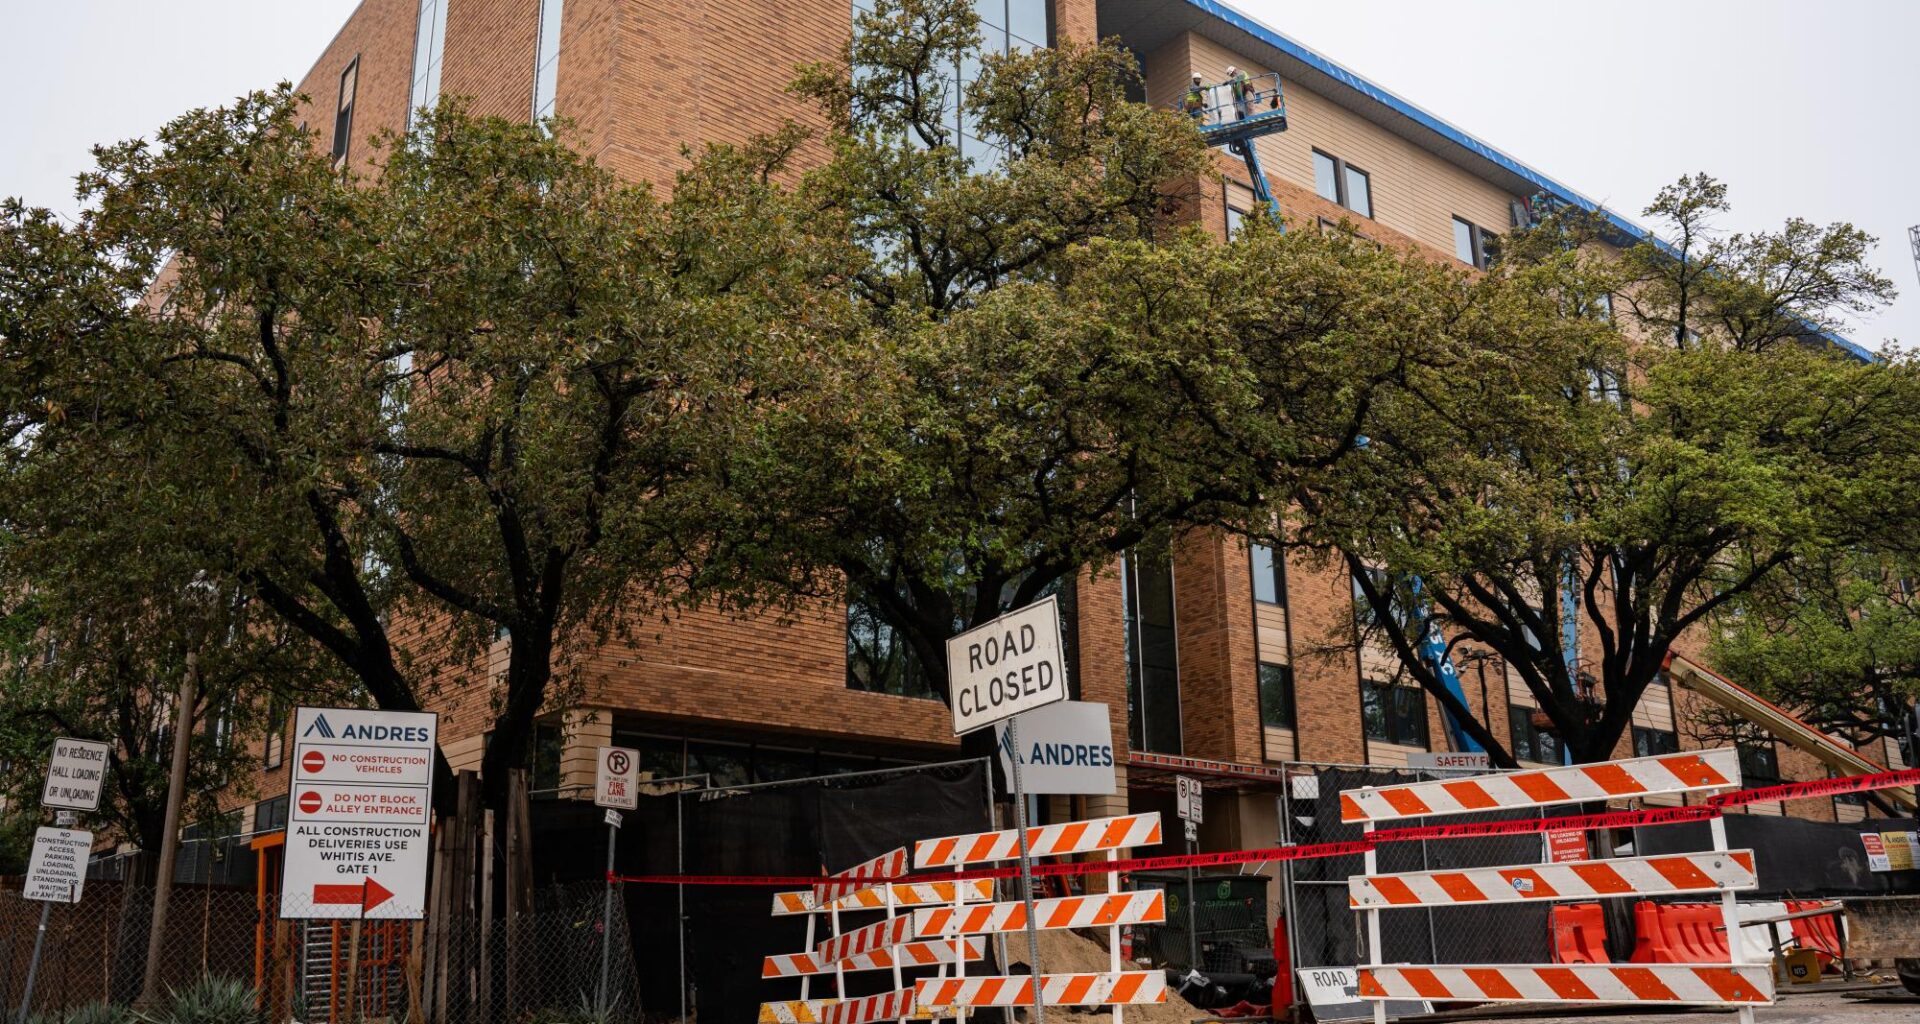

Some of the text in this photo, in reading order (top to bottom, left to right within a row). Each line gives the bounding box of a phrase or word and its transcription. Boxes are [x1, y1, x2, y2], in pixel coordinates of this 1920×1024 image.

[968, 623, 1035, 673] ROAD
[959, 660, 1054, 717] CLOSED
[342, 724, 429, 742] ANDRES
[57, 746, 104, 762] NO RESIDENCE
[332, 754, 426, 766] NO CONSTRUCTION
[1030, 742, 1113, 767] ANDRES
[1437, 756, 1476, 766] SAFETY
[52, 766, 101, 781] HALL LOADING
[356, 764, 402, 774] VEHICLES
[608, 788, 626, 796] LANE
[609, 782, 624, 790] FIRE
[1738, 789, 1786, 804] PELIGRO
[1807, 780, 1853, 795] DANGER
[49, 786, 95, 801] OR UNLOADING
[334, 794, 416, 804] DO NOT BLOCK
[326, 804, 422, 815] ALLEY ENTRANCE
[1603, 814, 1638, 826] DANGER
[296, 826, 421, 838] ALL CONSTRUCTION
[37, 837, 90, 848] CONSTRUCTION
[309, 838, 408, 850] DELIVERIES USE
[320, 852, 396, 862] WHITIS AVE.
[336, 864, 378, 874] GATE 1
[32, 876, 67, 884] STANDING
[38, 884, 68, 892] WAITING
[1312, 971, 1348, 988] ROAD
